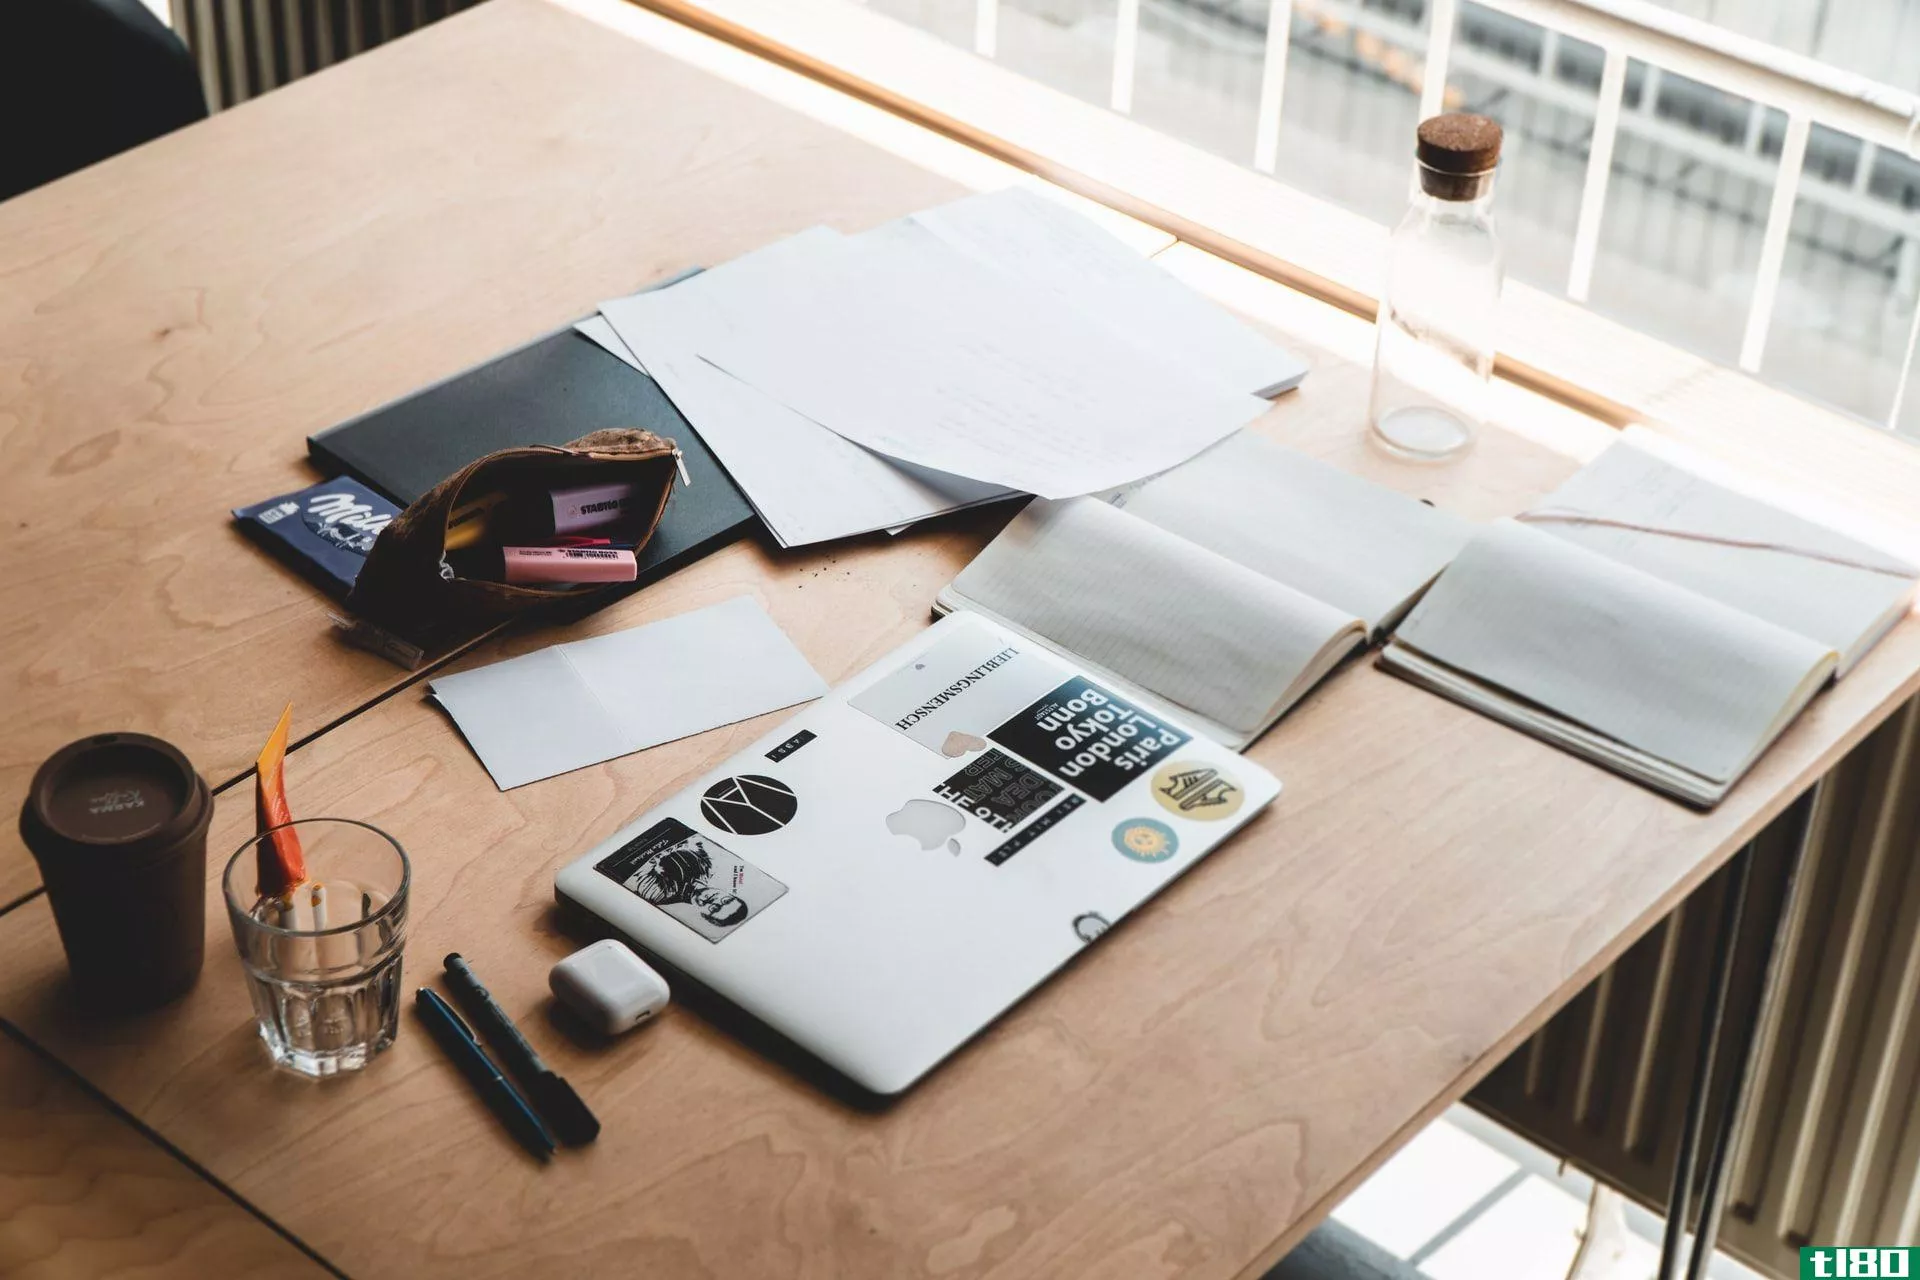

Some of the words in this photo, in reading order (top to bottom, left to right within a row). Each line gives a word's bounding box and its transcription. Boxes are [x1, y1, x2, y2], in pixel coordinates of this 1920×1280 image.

[895, 647, 1020, 731] LIEBLINGSMENSCH
[1037, 687, 1111, 731] Bonn
[1055, 697, 1136, 751] Tokyo
[1059, 713, 1159, 779] London
[1115, 727, 1182, 772] Paris
